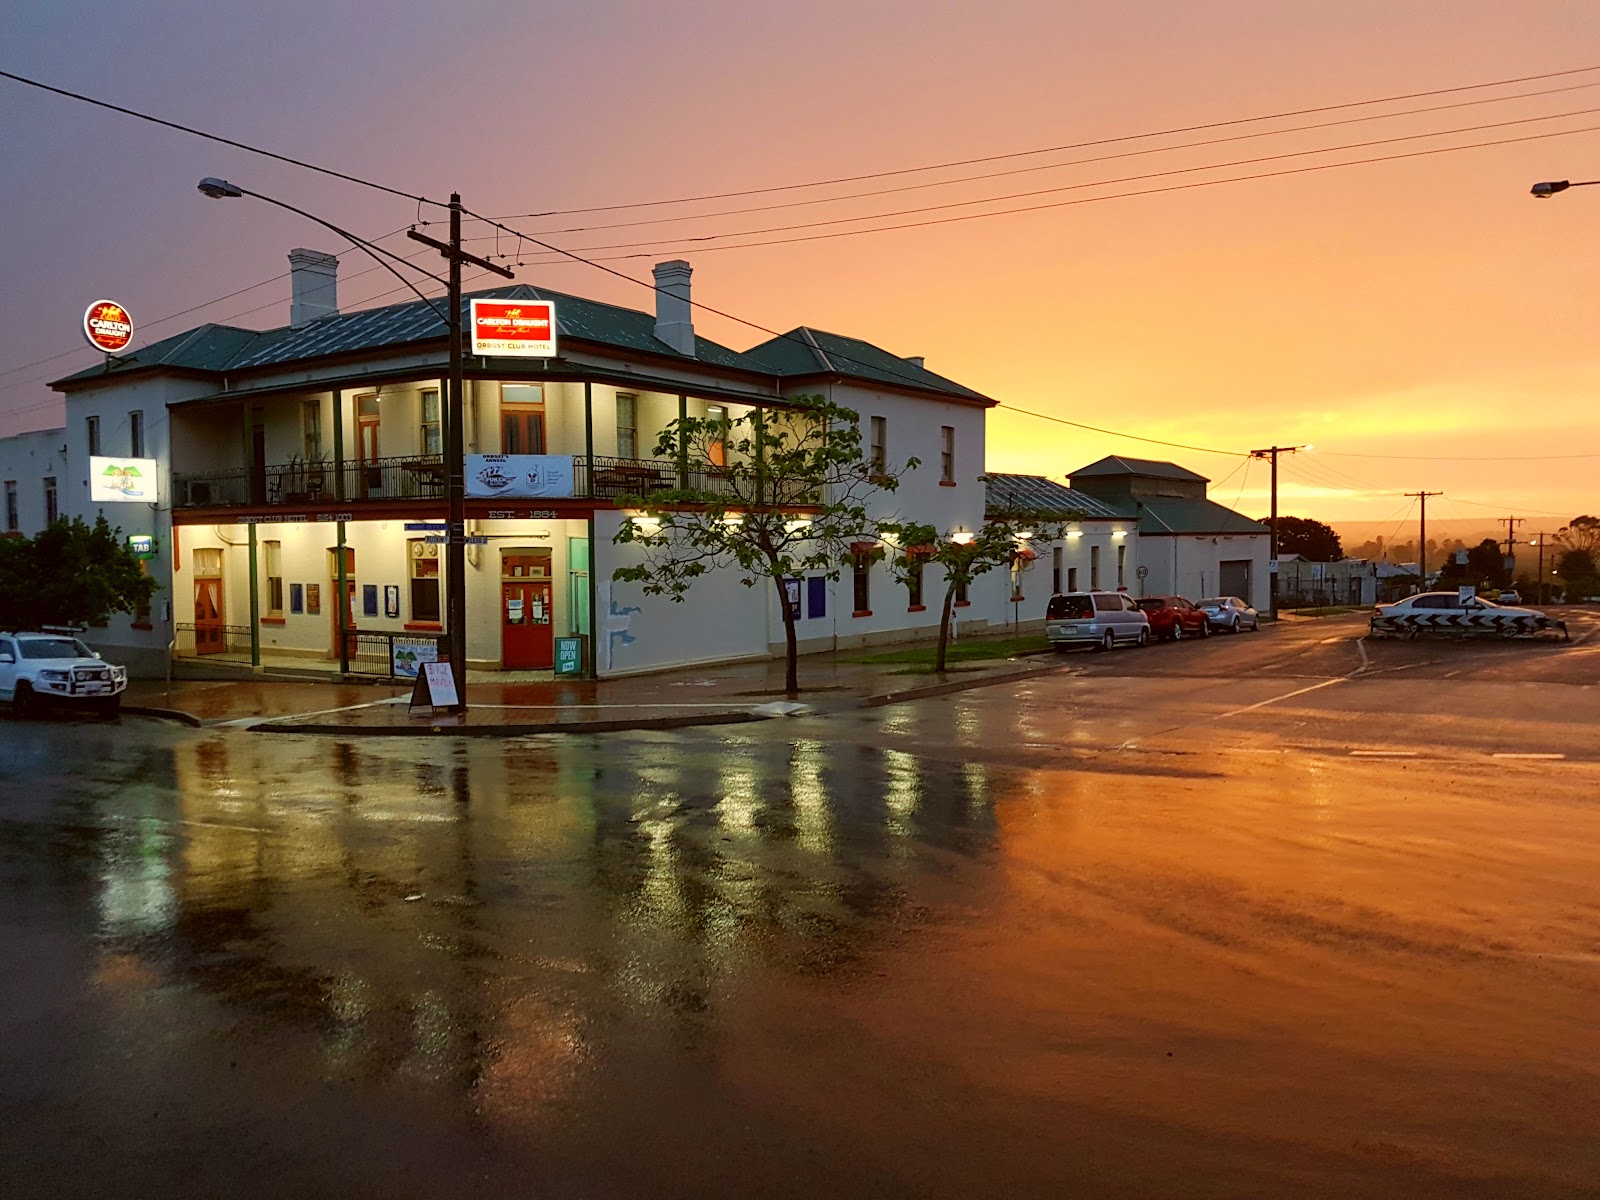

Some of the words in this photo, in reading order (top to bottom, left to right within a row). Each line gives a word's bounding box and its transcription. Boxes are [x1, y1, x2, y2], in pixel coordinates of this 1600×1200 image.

[89, 318, 131, 333] CARLTON
[476, 317, 511, 326] CARLTON
[512, 319, 549, 327] DRAUGHT
[94, 327, 127, 338] DRAUGHT
[237, 516, 263, 524] ORBOST
[263, 515, 283, 523] CLUB
[284, 514, 308, 522] HOTEL
[316, 514, 334, 522] 5154
[335, 513, 352, 521] 1003
[488, 510, 515, 519] EST.
[529, 510, 558, 519] 1884
[132, 543, 150, 552] TAB
[560, 640, 577, 651] NOW
[560, 650, 576, 660] OPEN
[427, 664, 448, 676] $12
[429, 678, 454, 687] MEALS
